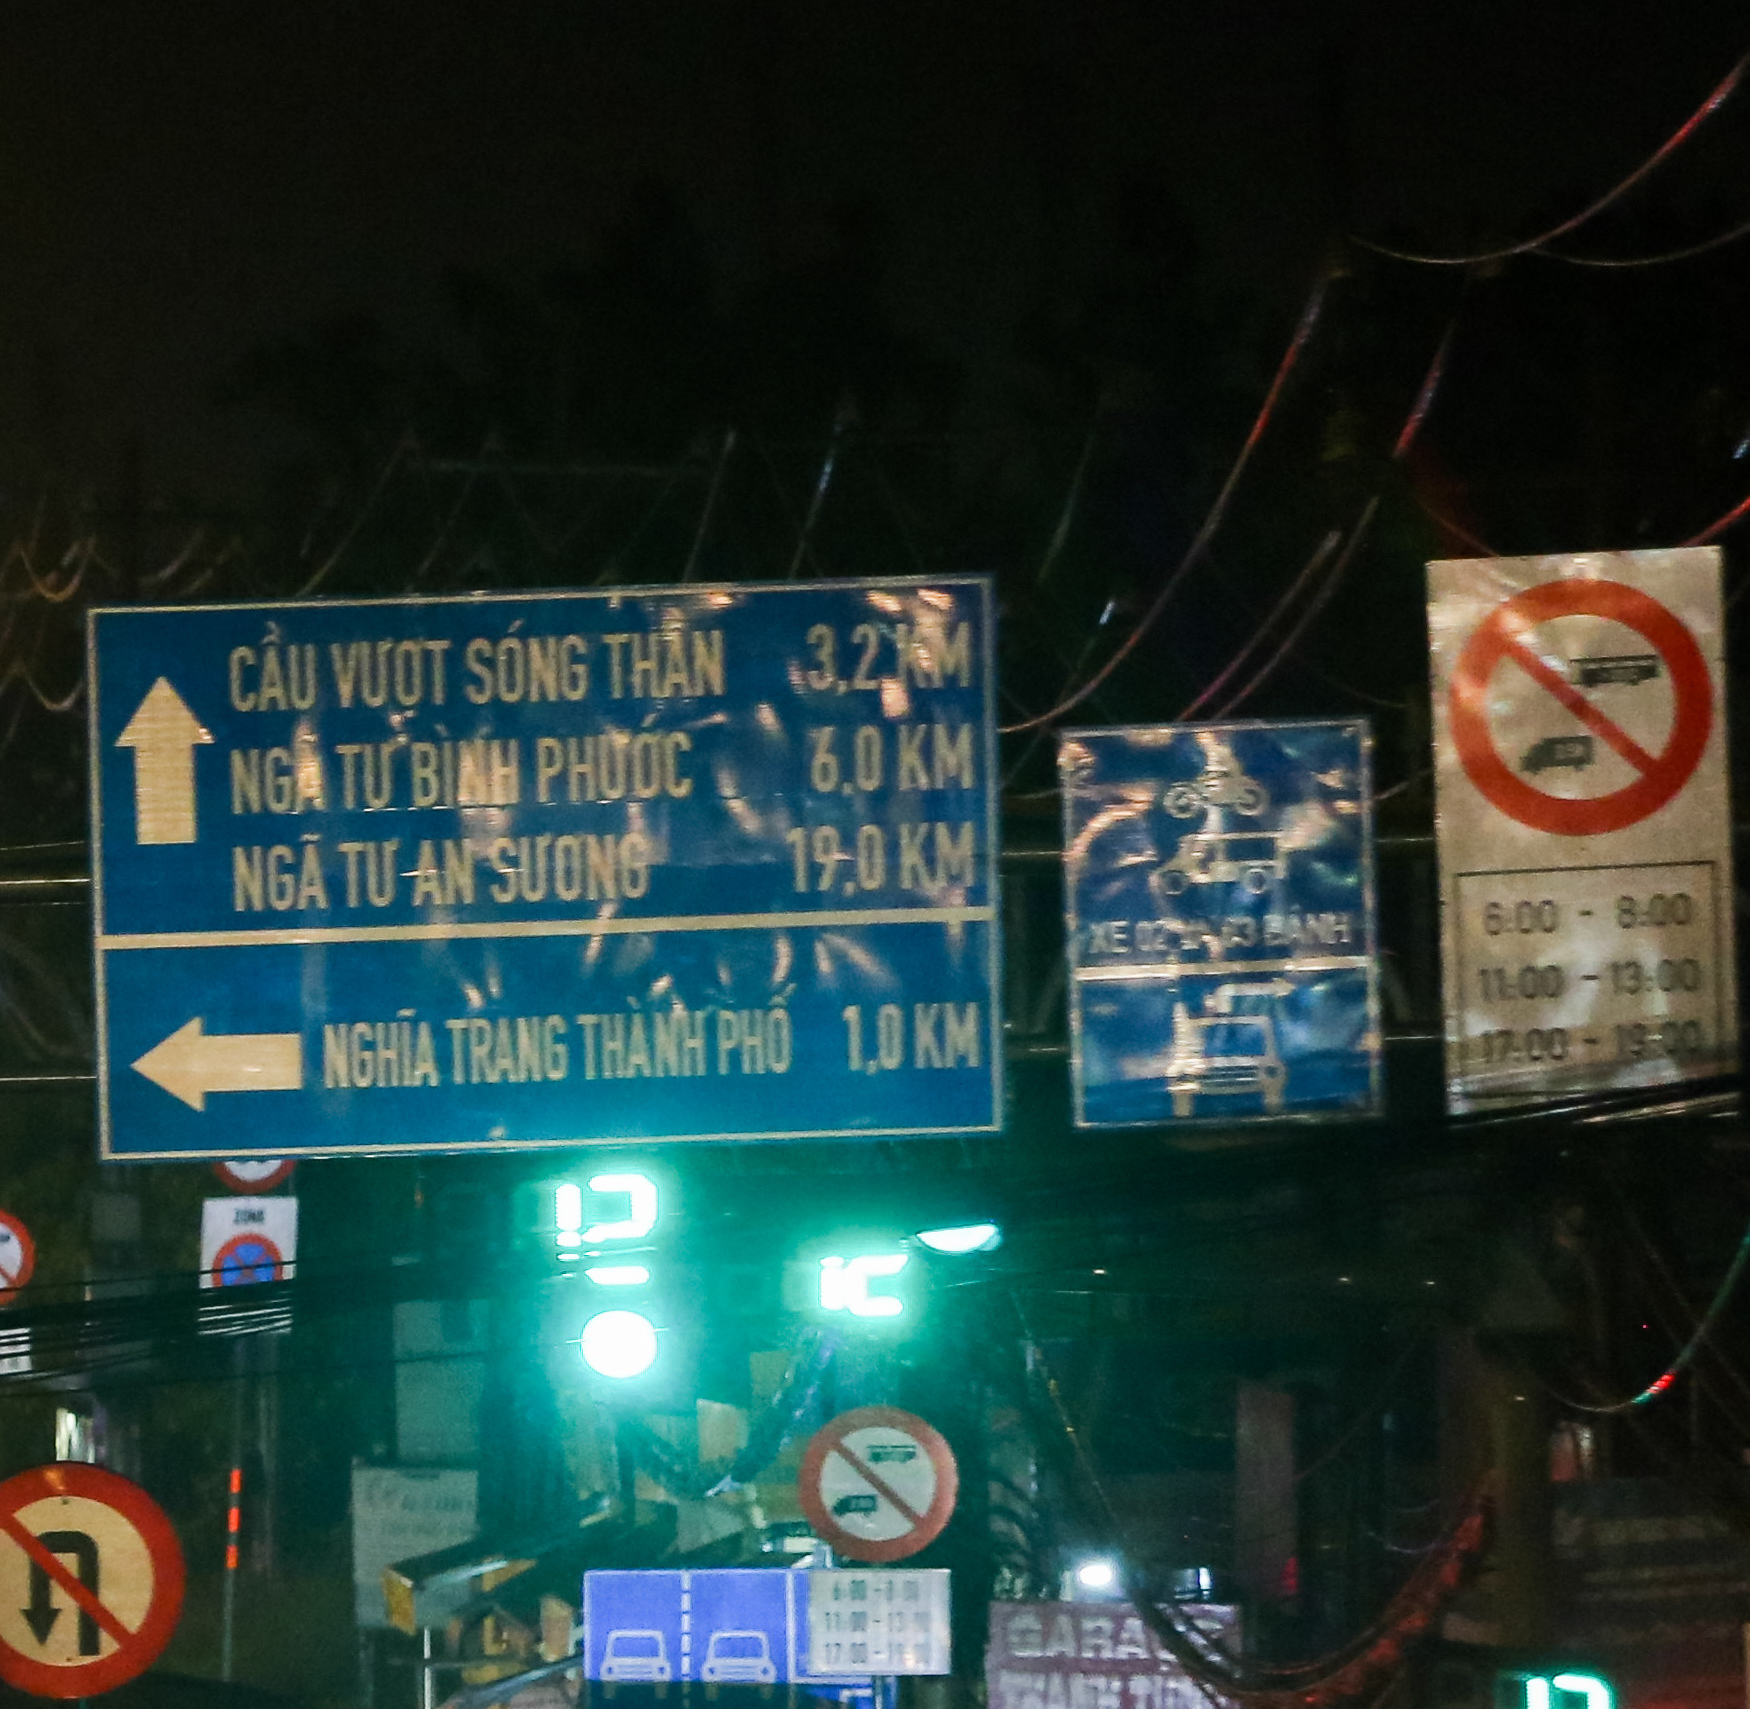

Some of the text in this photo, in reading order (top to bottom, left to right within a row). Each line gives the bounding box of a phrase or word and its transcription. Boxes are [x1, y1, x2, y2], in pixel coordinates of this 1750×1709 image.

[229, 620, 318, 712] CẦU
[464, 619, 589, 706] SÓNG
[896, 621, 971, 688] KM
[411, 722, 519, 808] BÌNH
[536, 714, 693, 804] PHƯỚC
[898, 723, 974, 791] KM
[231, 832, 329, 913] NGÃ
[336, 838, 400, 909] TƯ
[411, 839, 476, 908] AN
[898, 821, 975, 892] KM
[1089, 920, 1130, 953] XE
[323, 983, 795, 1091] NGHĨA TRANG THÀNH PHỐ
[913, 1001, 982, 1070] KM
